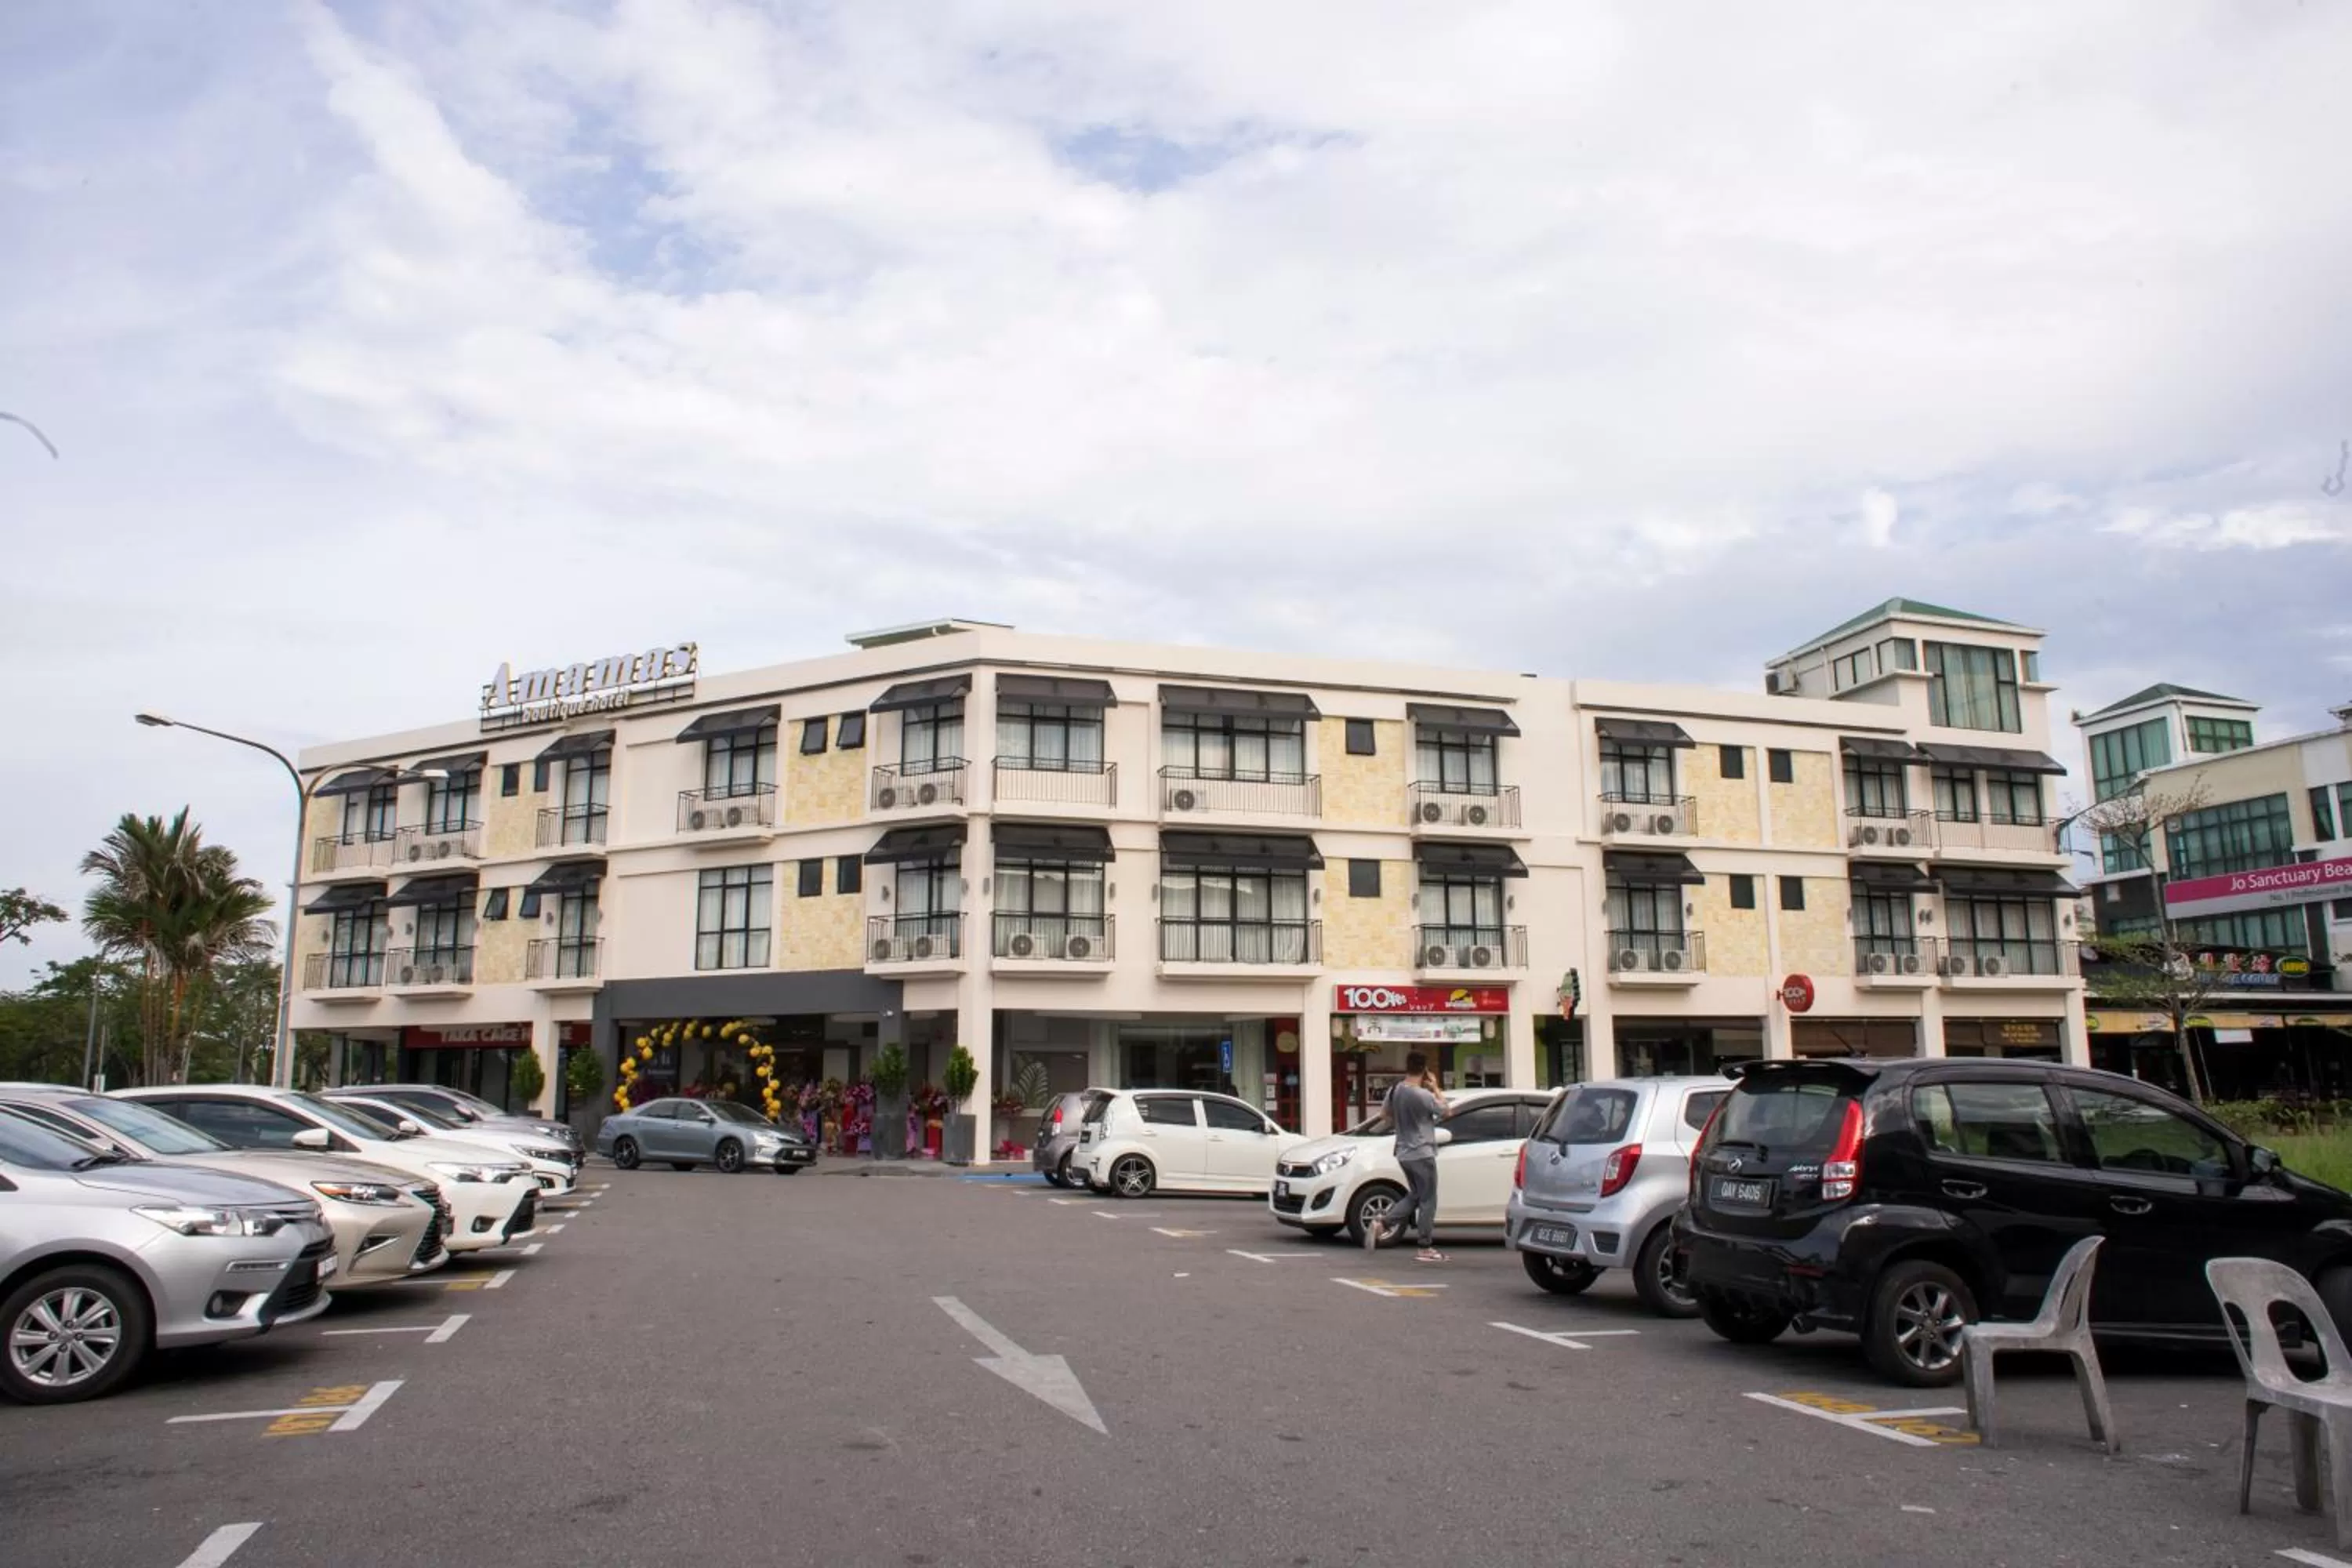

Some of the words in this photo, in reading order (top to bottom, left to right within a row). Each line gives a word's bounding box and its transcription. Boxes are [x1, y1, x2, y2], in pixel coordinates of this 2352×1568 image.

[484, 641, 696, 709] Amamas
[522, 698, 584, 723] boutique
[586, 689, 630, 713] hotel
[2230, 877, 2245, 891] Jo
[2248, 867, 2321, 888] Sanctuary
[2324, 863, 2352, 878] Bea
[481, 1027, 520, 1042] CAKE
